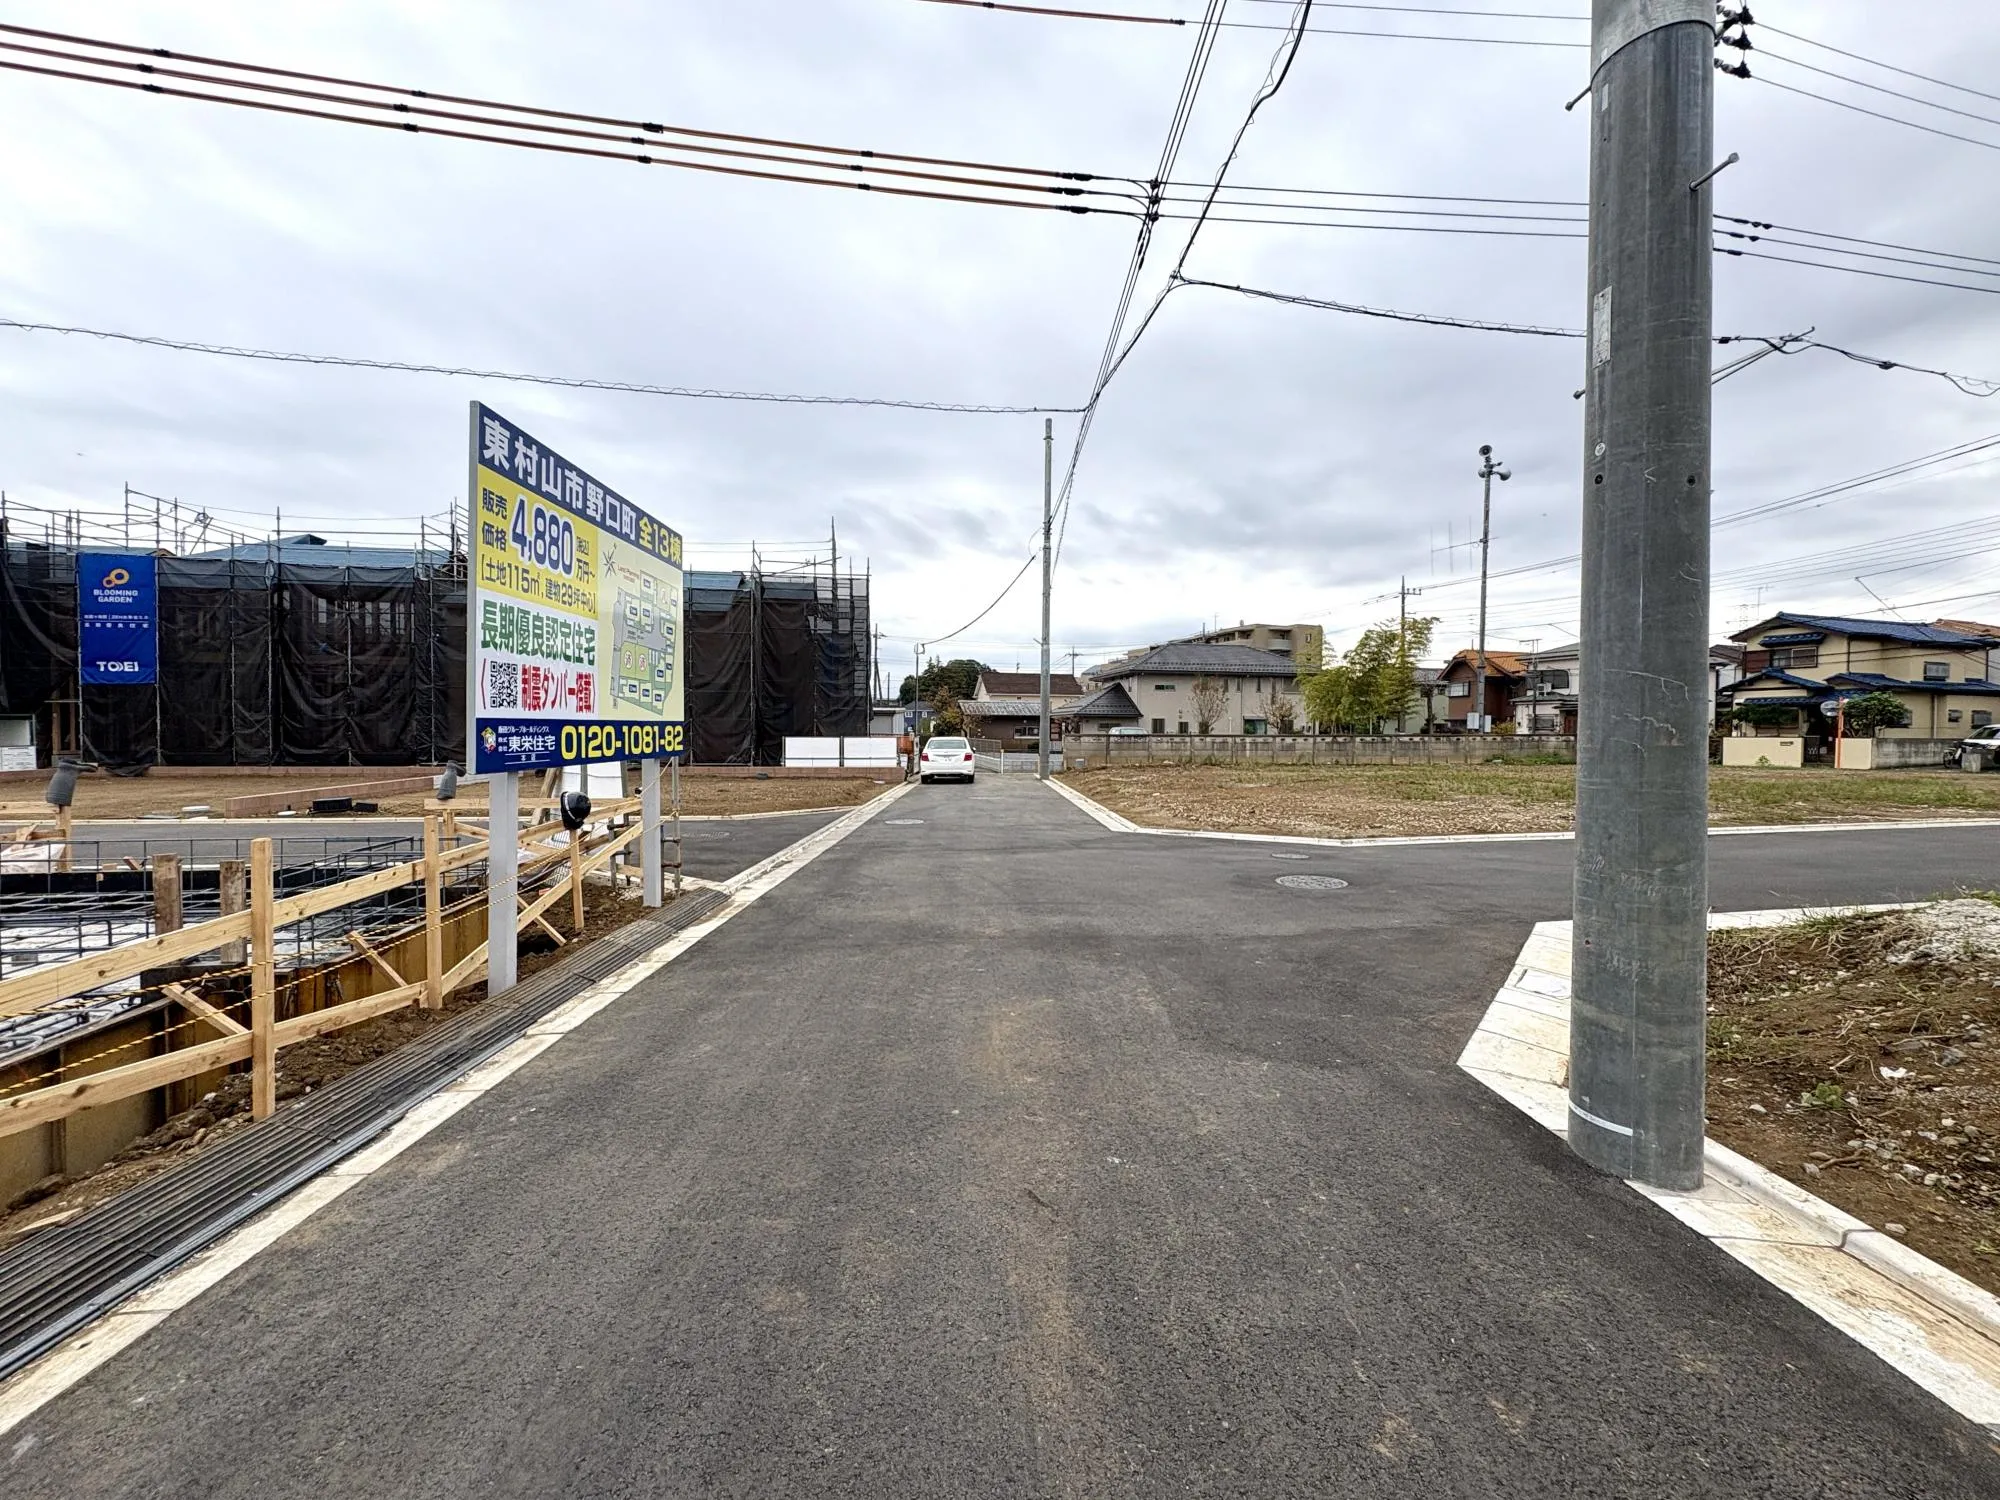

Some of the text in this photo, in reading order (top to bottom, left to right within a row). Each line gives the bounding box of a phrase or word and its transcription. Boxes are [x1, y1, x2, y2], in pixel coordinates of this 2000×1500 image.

[482, 487, 507, 520] 販売
[483, 416, 682, 565] 東村山市野口町 全13棟
[482, 497, 575, 577] 価格 4,880
[93, 589, 138, 597] BLOOMING
[480, 599, 596, 666] 長期優良認定住宅
[96, 661, 139, 672] TOEI
[508, 735, 556, 752] 東栄住宅
[561, 725, 684, 760] 0120-1081-82
